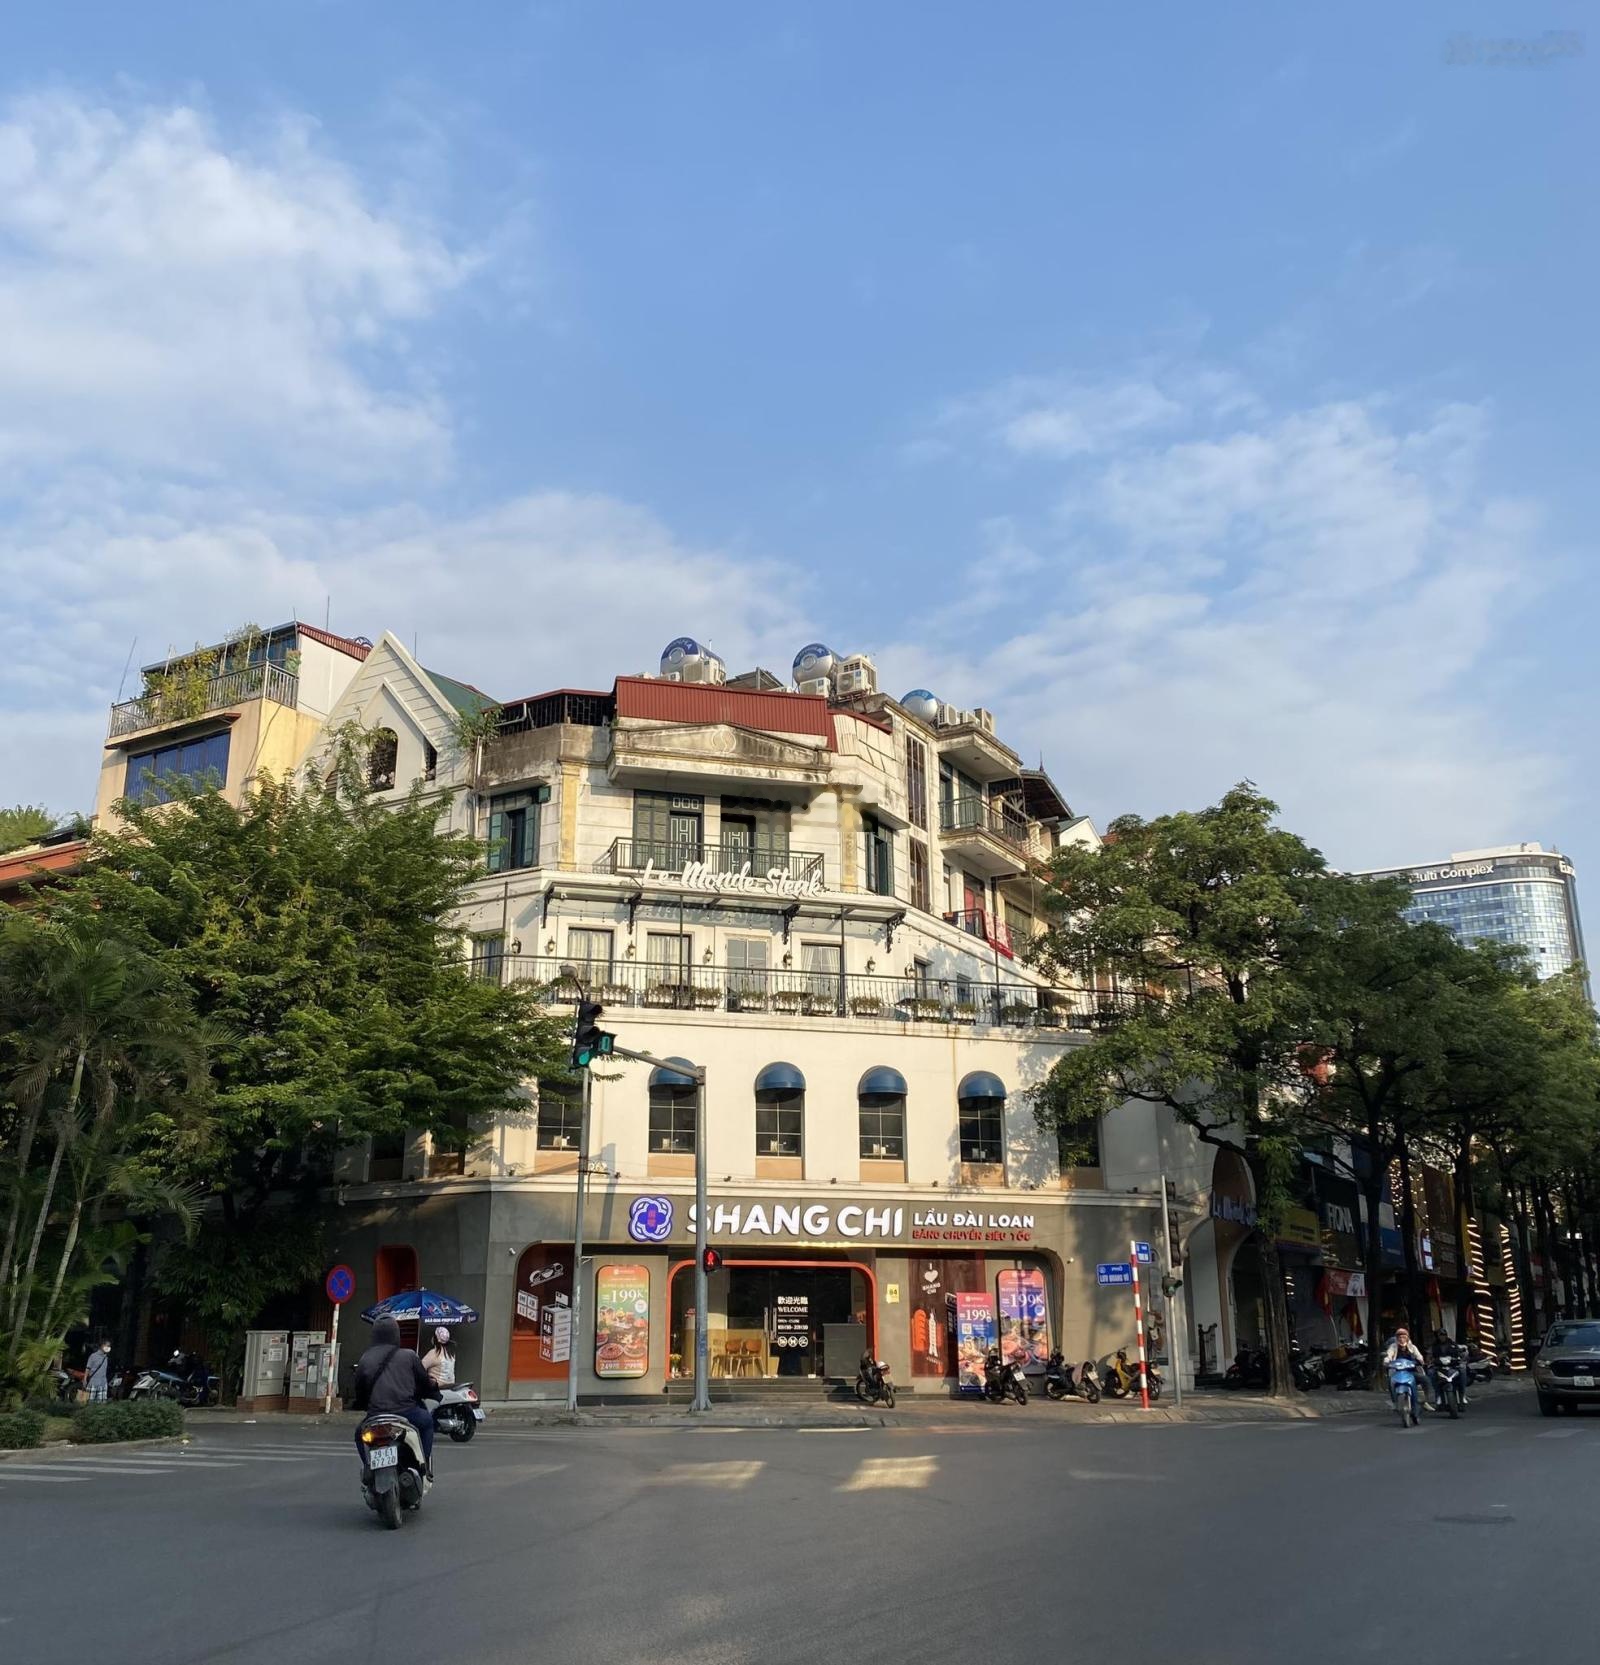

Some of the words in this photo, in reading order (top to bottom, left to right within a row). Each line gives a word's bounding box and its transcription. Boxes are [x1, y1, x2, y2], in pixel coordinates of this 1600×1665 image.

[642, 857, 669, 886] Le
[681, 861, 755, 892] Monde
[766, 868, 822, 897] Steak
[1440, 864, 1495, 880] Complex
[686, 1203, 830, 1237] SHANG
[836, 1205, 904, 1238] CHI
[952, 1209, 983, 1227] ĐÀI
[988, 1214, 1035, 1228] LOAN
